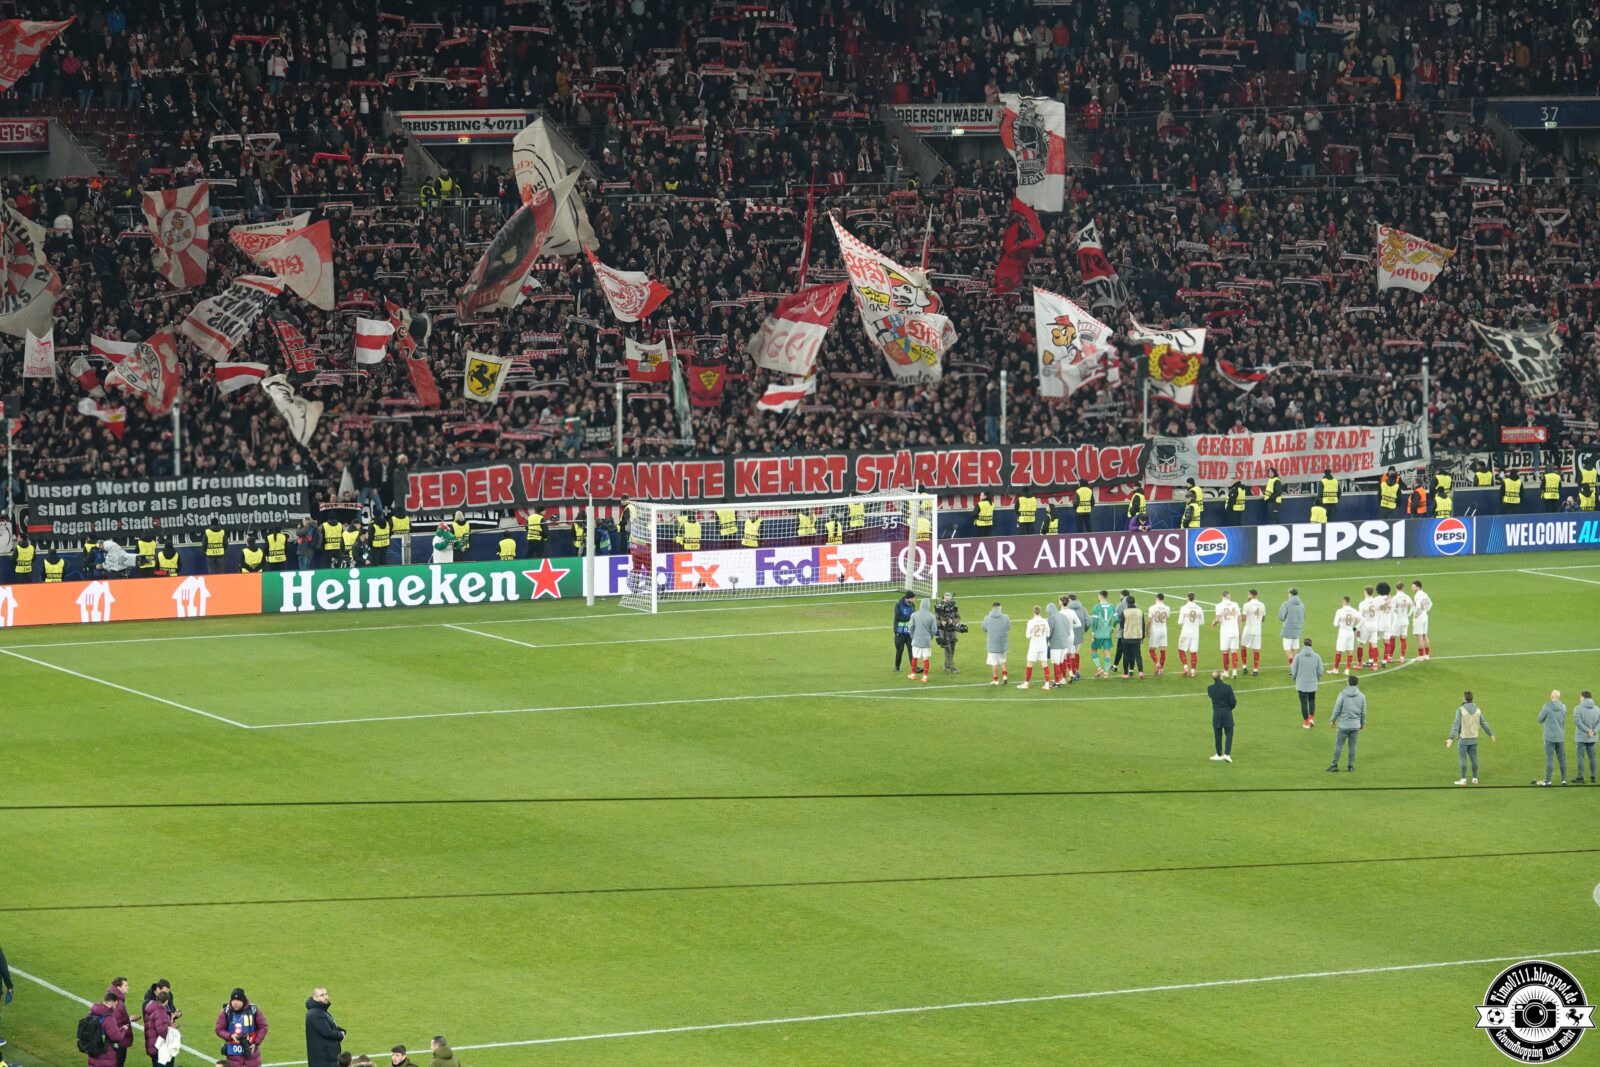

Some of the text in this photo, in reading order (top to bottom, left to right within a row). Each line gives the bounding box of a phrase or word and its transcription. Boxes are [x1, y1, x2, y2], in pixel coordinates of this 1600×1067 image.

[404, 119, 525, 132] BRUSTRING 0711
[1540, 106, 1559, 121] 37
[1196, 429, 1375, 457] GEGEN ALLE STADT-
[1197, 451, 1374, 480] UND STADIONVERBOTE!
[27, 483, 92, 498] Unsere
[96, 481, 150, 495] Werte
[154, 477, 188, 493] und
[405, 443, 1146, 513] JEDER VERBANNTE KEHRT STÄRKER ZURÜCK
[37, 501, 77, 517] sind
[81, 499, 146, 515] stärker
[151, 497, 178, 511] als
[182, 494, 233, 510] jedes
[236, 491, 301, 507] Verbot!
[53, 520, 92, 535] Gegen
[94, 517, 118, 532] alle
[160, 513, 184, 528] und
[881, 516, 898, 529] 35
[1505, 521, 1577, 547] WELCOME
[1196, 542, 1228, 552] PEPSI
[1256, 519, 1405, 564] PEPSI
[1436, 532, 1465, 541] PEPSI
[755, 545, 865, 587] FedEx
[897, 533, 1181, 580] QATAR AIRWAYS
[279, 564, 519, 613] Heineken
[1103, 608, 1108, 622] 1
[1033, 624, 1046, 637] 27
